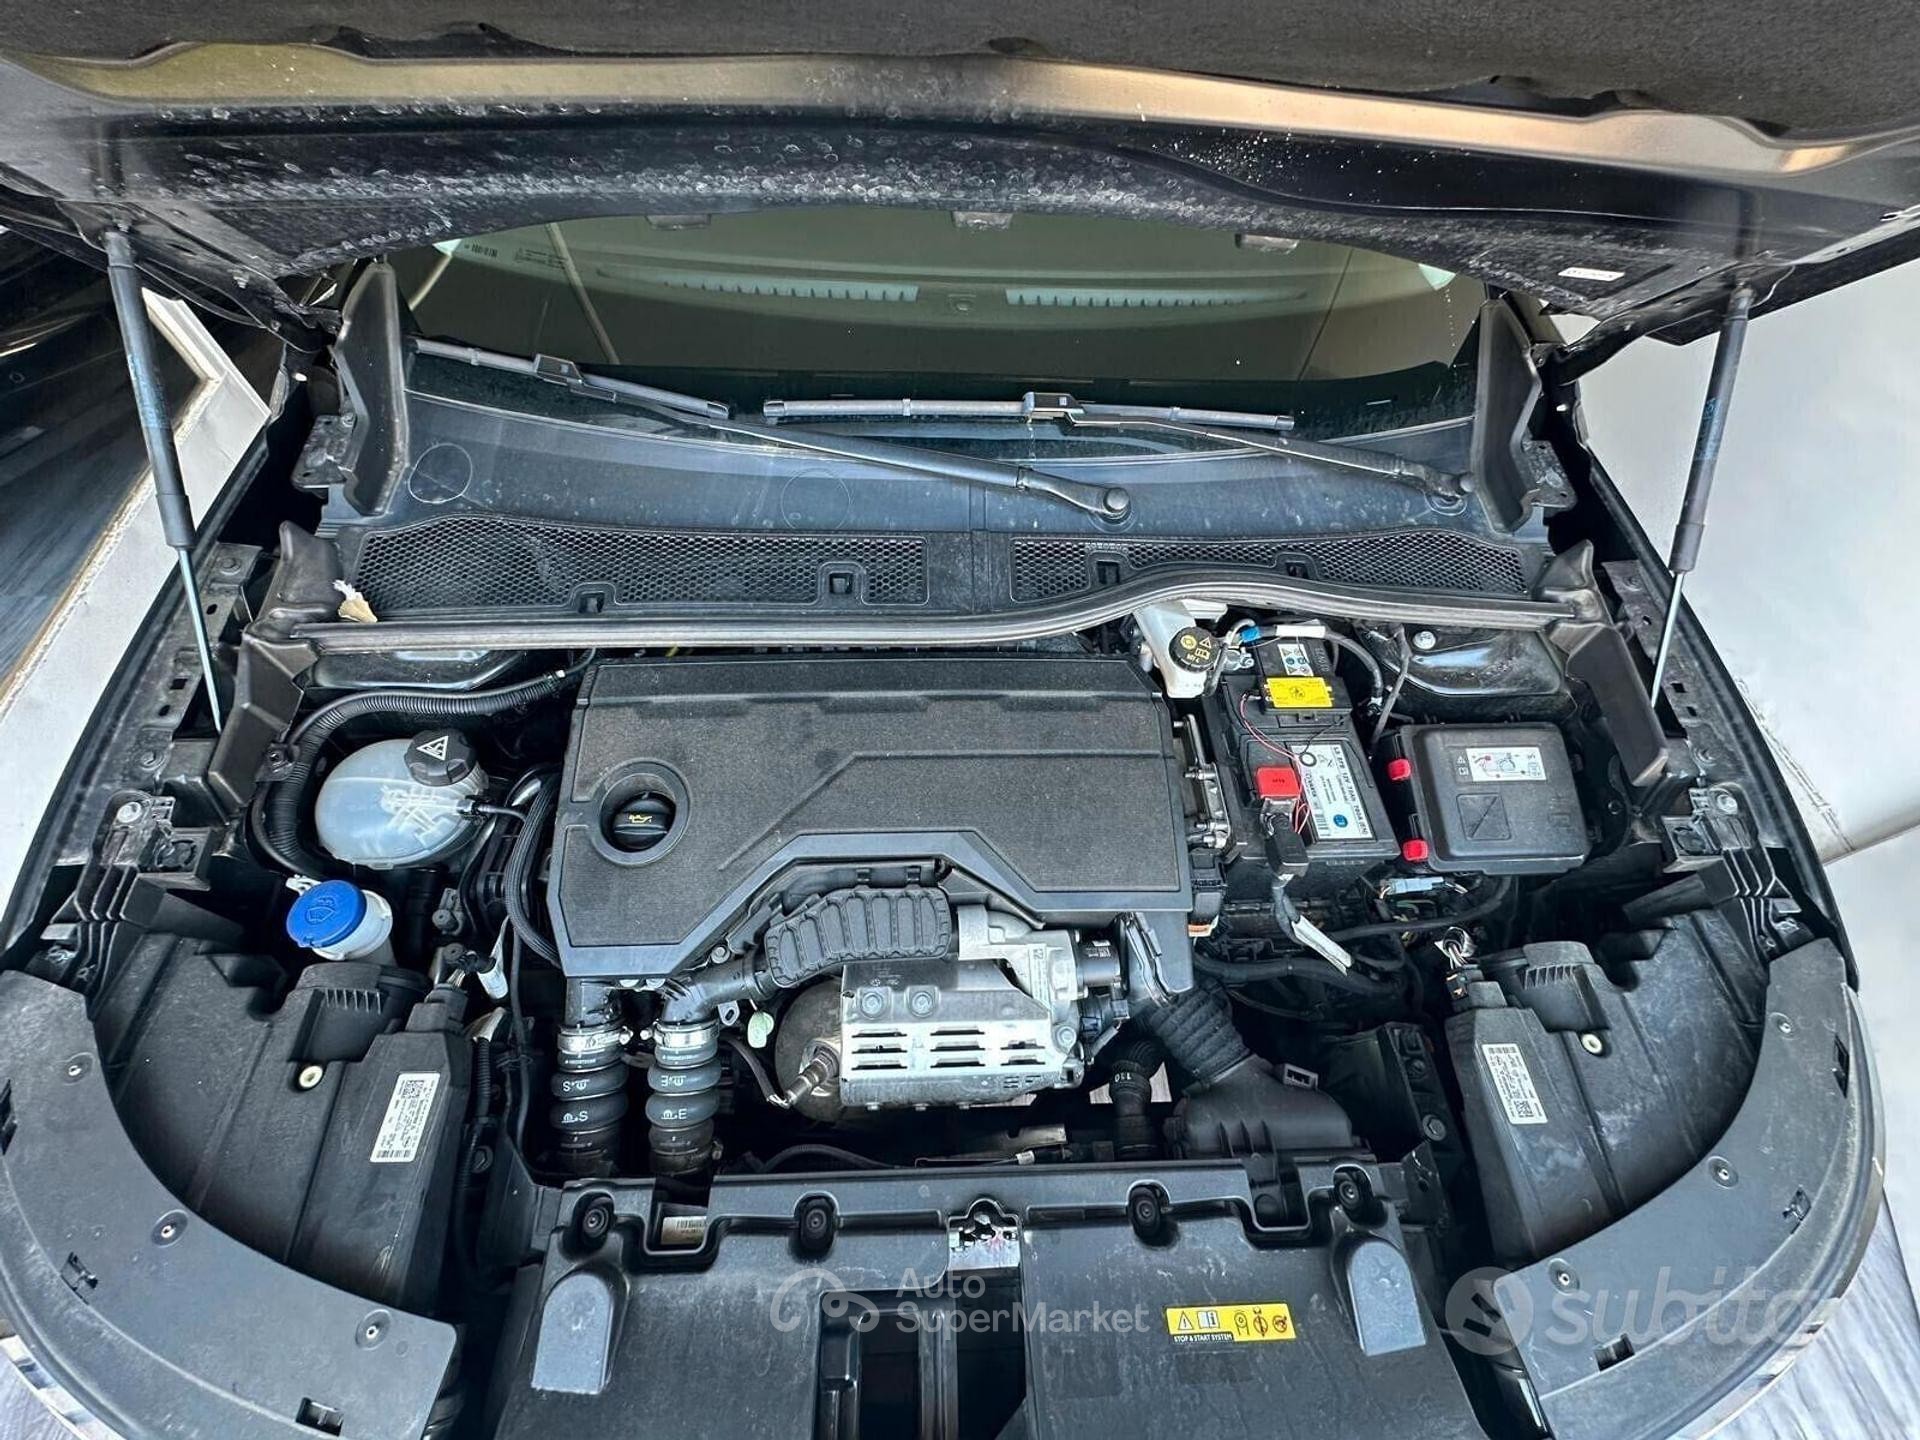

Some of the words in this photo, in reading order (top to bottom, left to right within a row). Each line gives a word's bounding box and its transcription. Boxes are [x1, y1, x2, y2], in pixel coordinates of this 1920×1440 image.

[1173, 1335, 1188, 1343] STOP
[1194, 1334, 1211, 1342] START
[1211, 1333, 1233, 1341] SYSTEM
